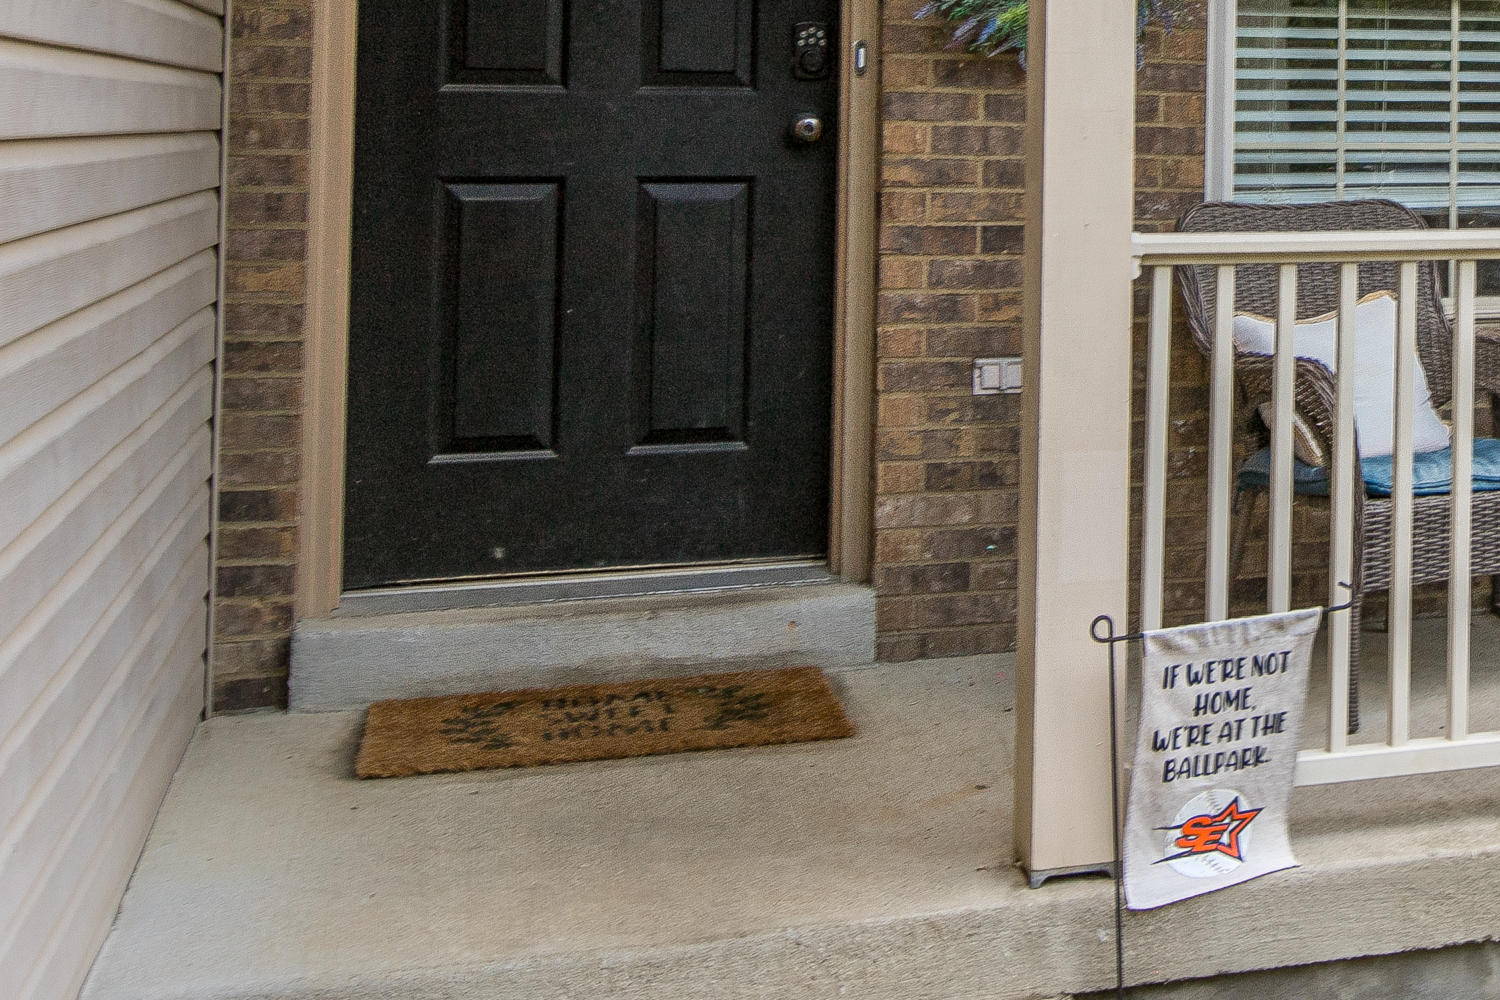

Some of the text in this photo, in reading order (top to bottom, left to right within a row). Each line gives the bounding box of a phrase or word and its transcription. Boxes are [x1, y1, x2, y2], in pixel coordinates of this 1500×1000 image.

[1162, 651, 1292, 689] IF WE'RE NOT
[1151, 711, 1288, 751] WE'RE AT THE
